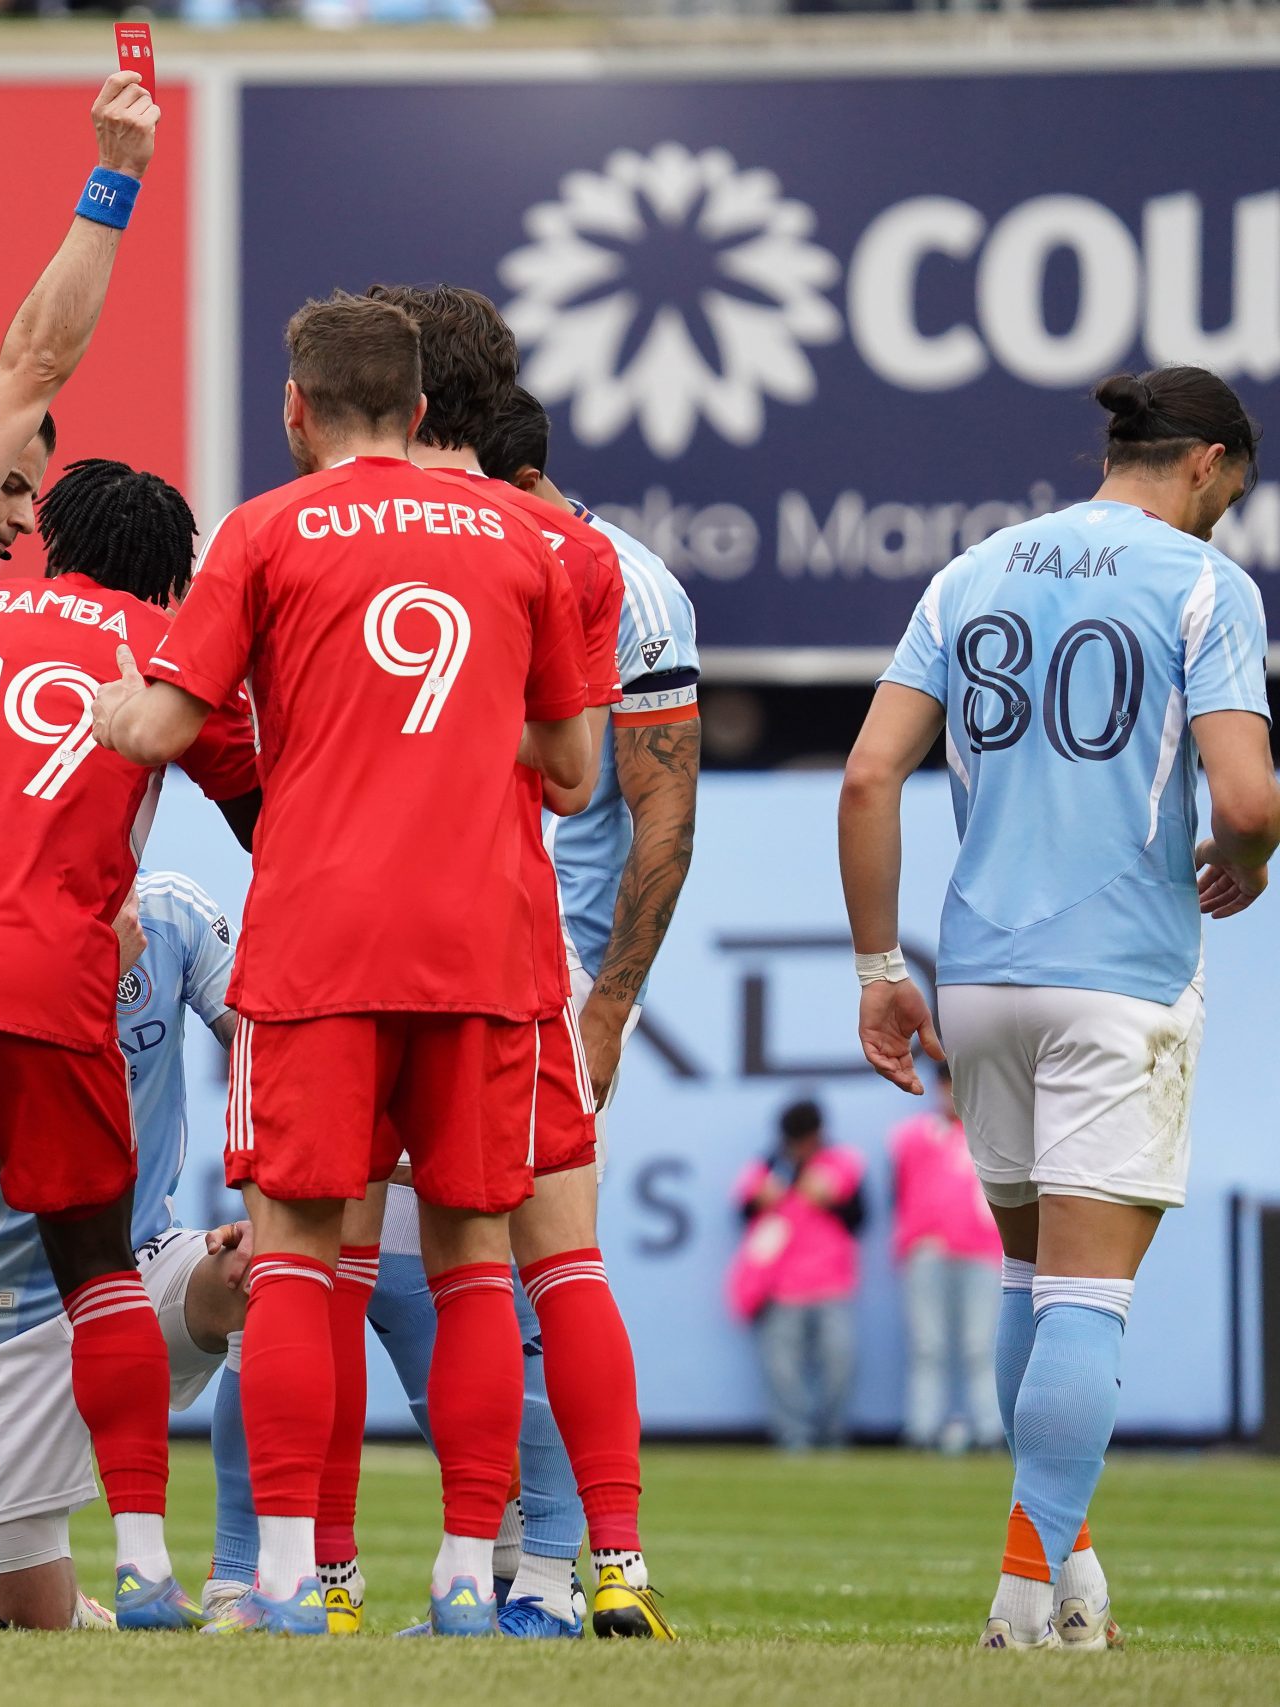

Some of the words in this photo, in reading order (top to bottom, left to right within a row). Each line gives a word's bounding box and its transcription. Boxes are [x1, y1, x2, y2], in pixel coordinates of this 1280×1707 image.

[297, 498, 505, 540] CUYPERS
[1005, 541, 1129, 580] HAAK
[363, 580, 471, 735] 9
[642, 641, 662, 655] MLS
[956, 609, 1145, 763] 80
